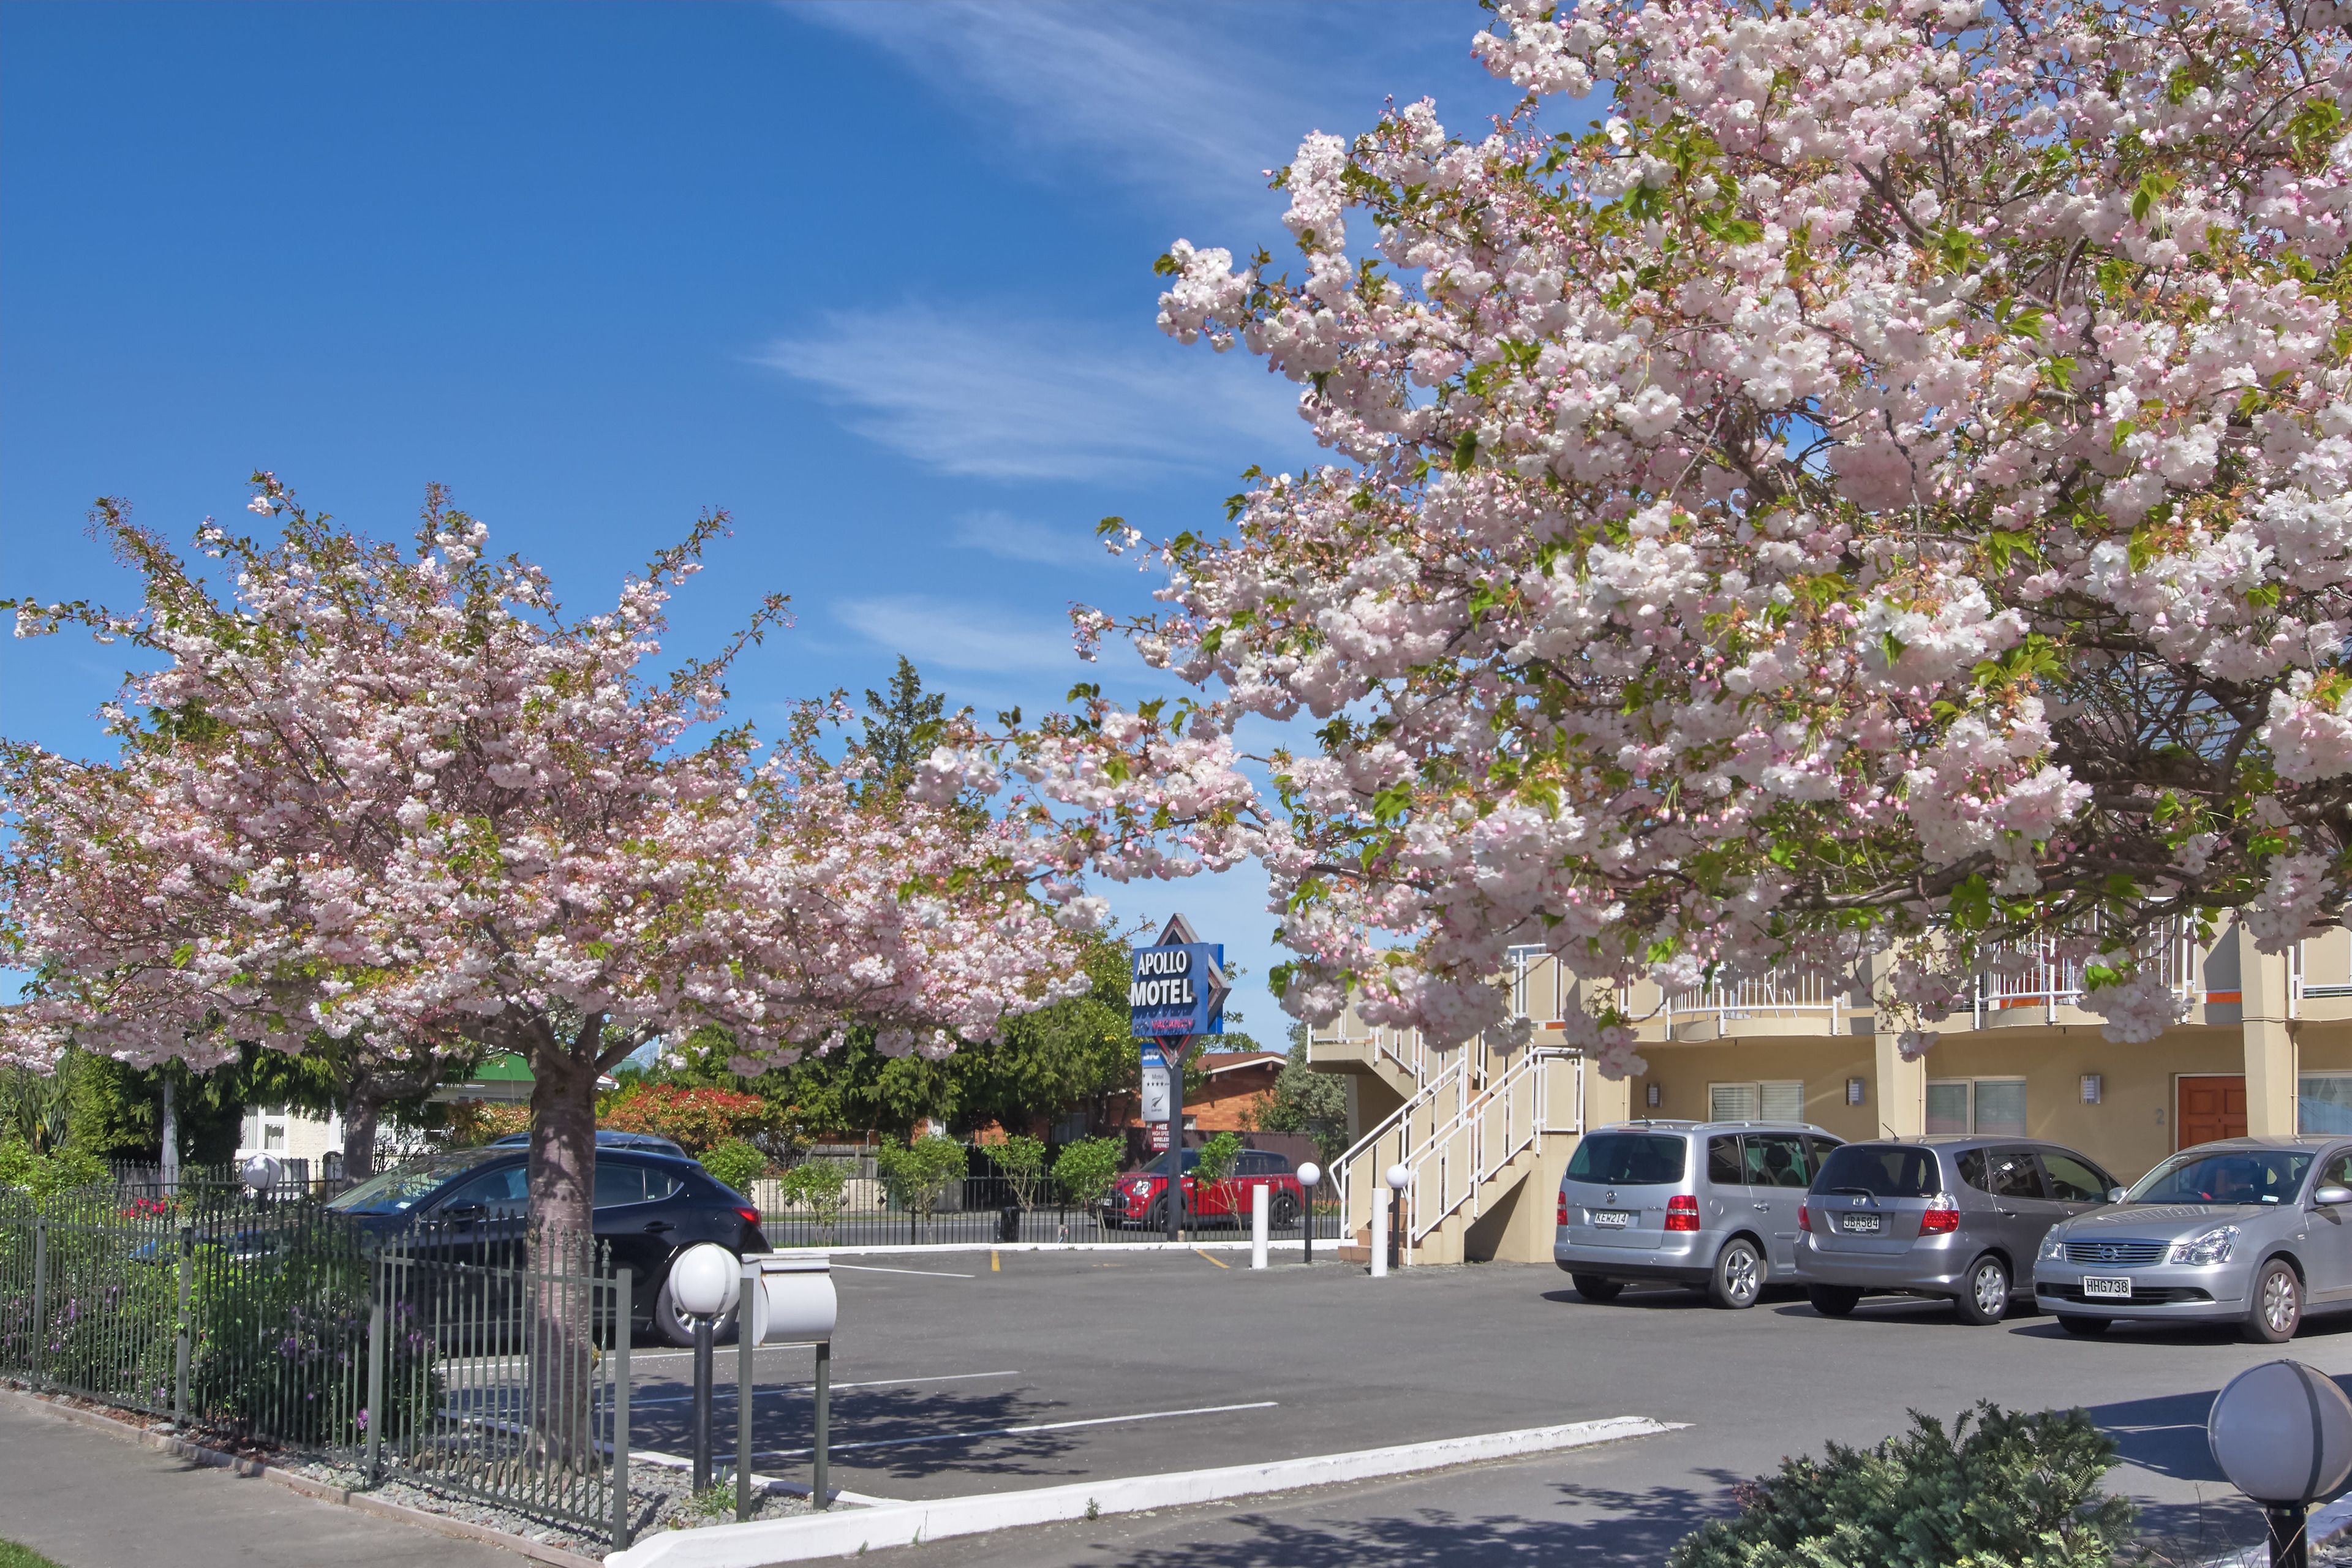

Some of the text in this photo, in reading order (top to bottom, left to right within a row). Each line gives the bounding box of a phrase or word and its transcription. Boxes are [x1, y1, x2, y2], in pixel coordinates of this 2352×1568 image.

[1137, 950, 1187, 975] APOLLO
[1131, 978, 1192, 1006] MOTEL
[1152, 1019, 1194, 1030] VACANCY
[2156, 1107, 2165, 1125] 2
[1844, 1216, 1878, 1227] JBA504
[2086, 1280, 2127, 1292] HHG738
